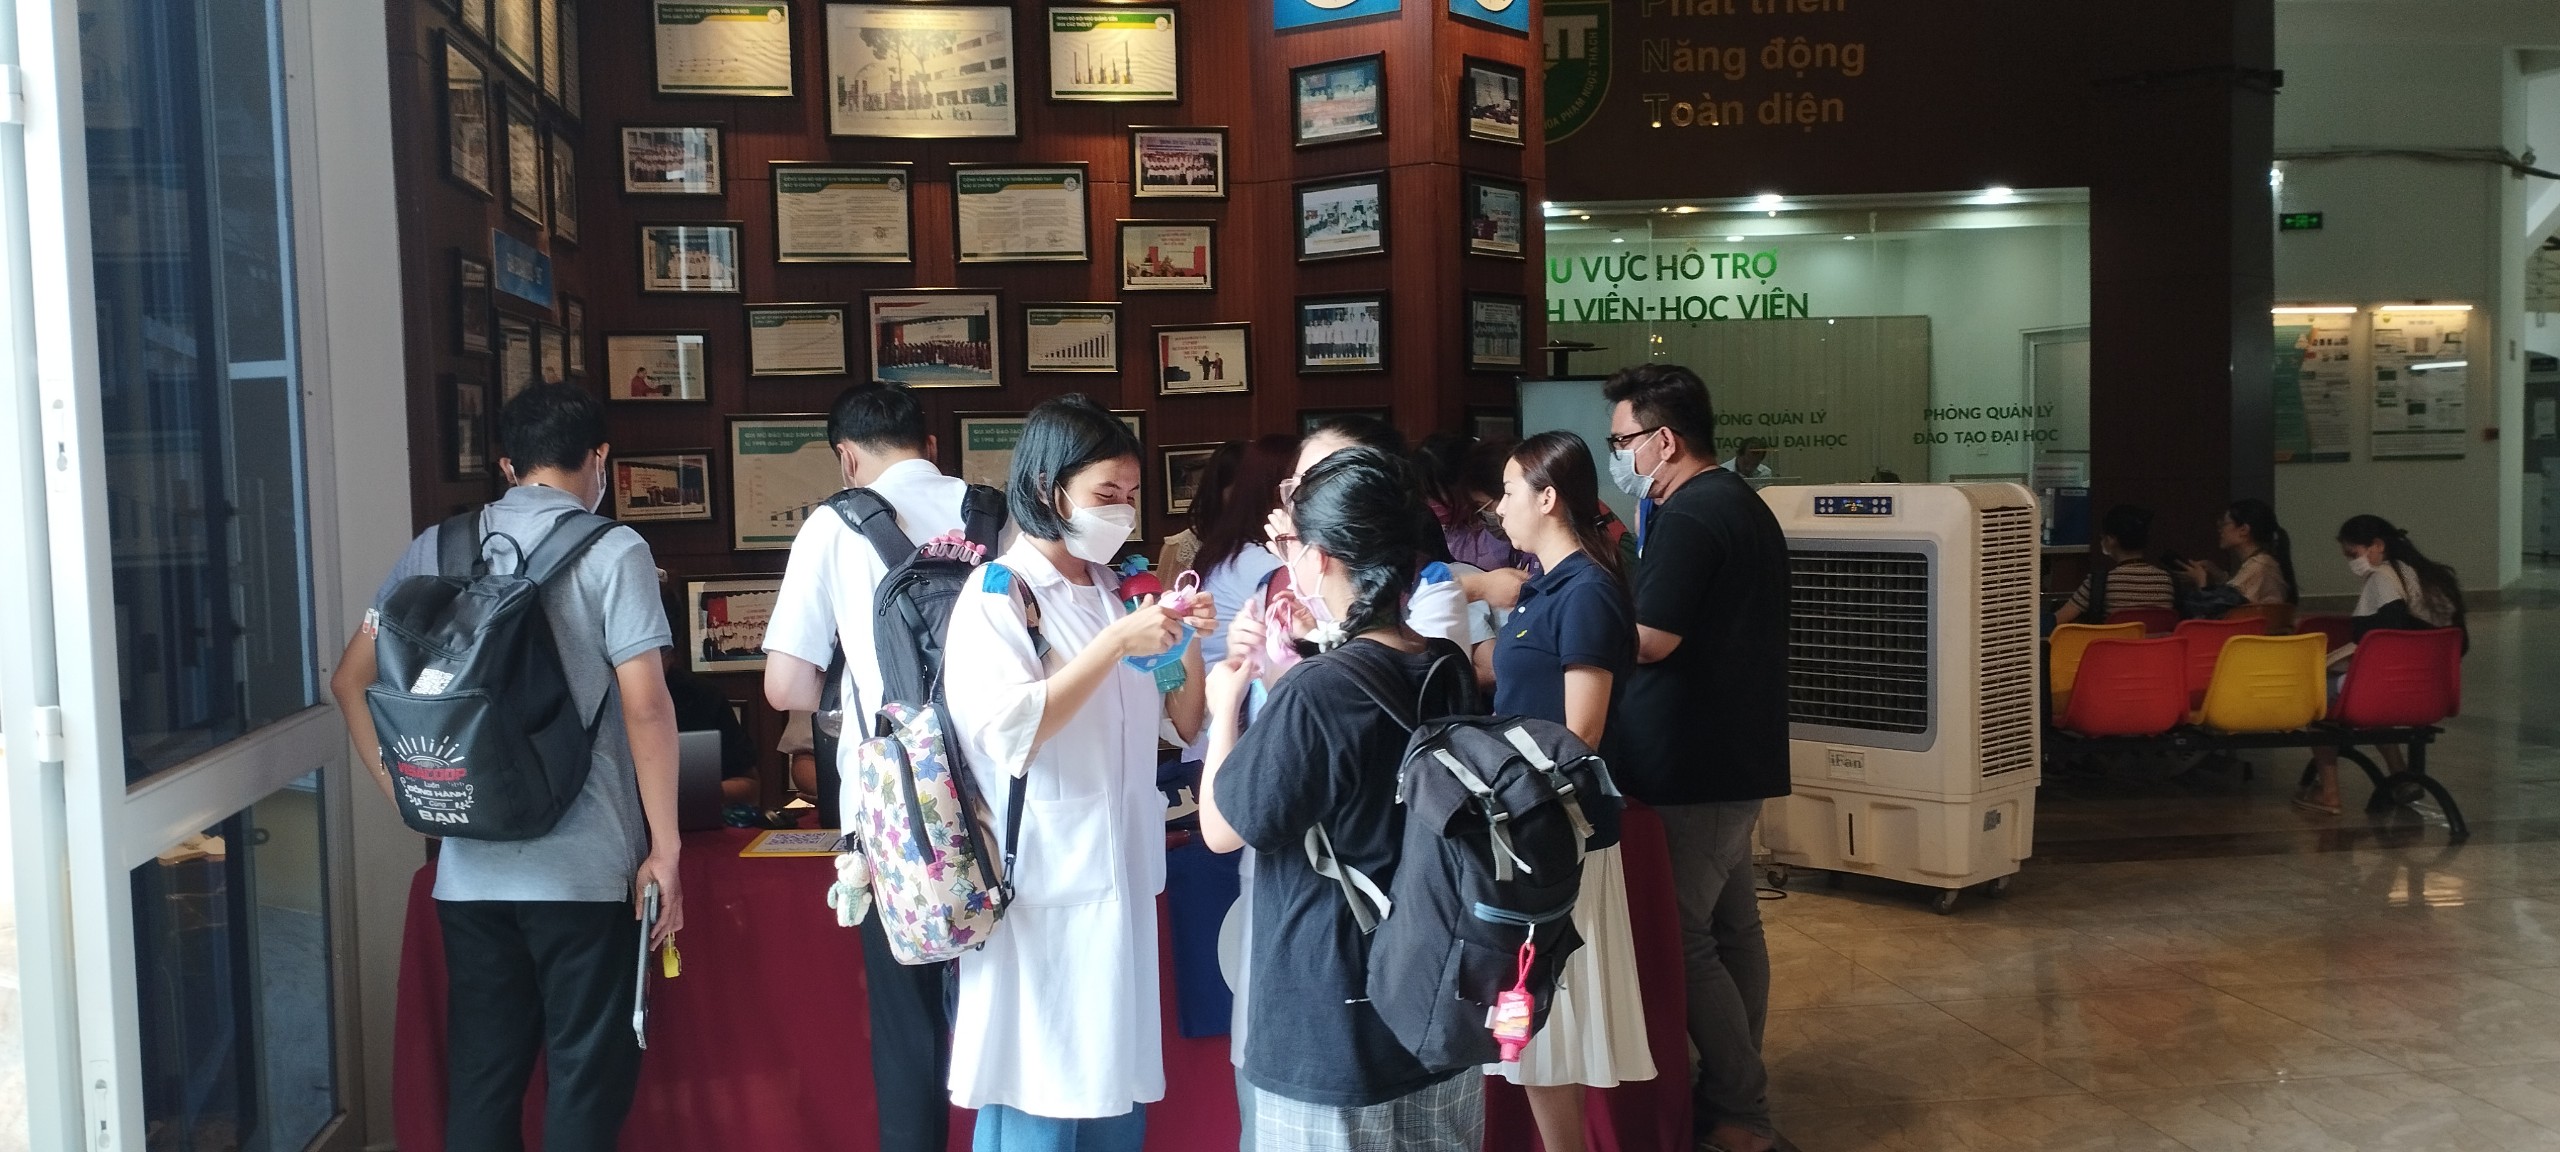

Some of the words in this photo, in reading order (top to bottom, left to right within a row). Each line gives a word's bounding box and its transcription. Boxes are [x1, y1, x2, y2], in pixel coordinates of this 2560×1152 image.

[1642, 38, 1746, 80] Năng
[1760, 36, 1865, 78] động
[1642, 91, 1744, 127] Toàn
[1757, 91, 1844, 132] diện
[1580, 251, 1648, 289] VỰC
[1710, 248, 1778, 285] TRỢ
[1736, 287, 1809, 320] VIÊN
[1923, 403, 1981, 421] PHÒNG
[1986, 402, 2033, 420] QUẢN
[1783, 435, 1810, 451] ĐẠI
[1814, 434, 1848, 450] HỌC
[1954, 430, 1987, 447] TẠO
[1991, 429, 2019, 446] ĐẠI
[2023, 428, 2059, 445] HỌC
[1830, 753, 1863, 768] iFan
[418, 809, 469, 825] BẠN
